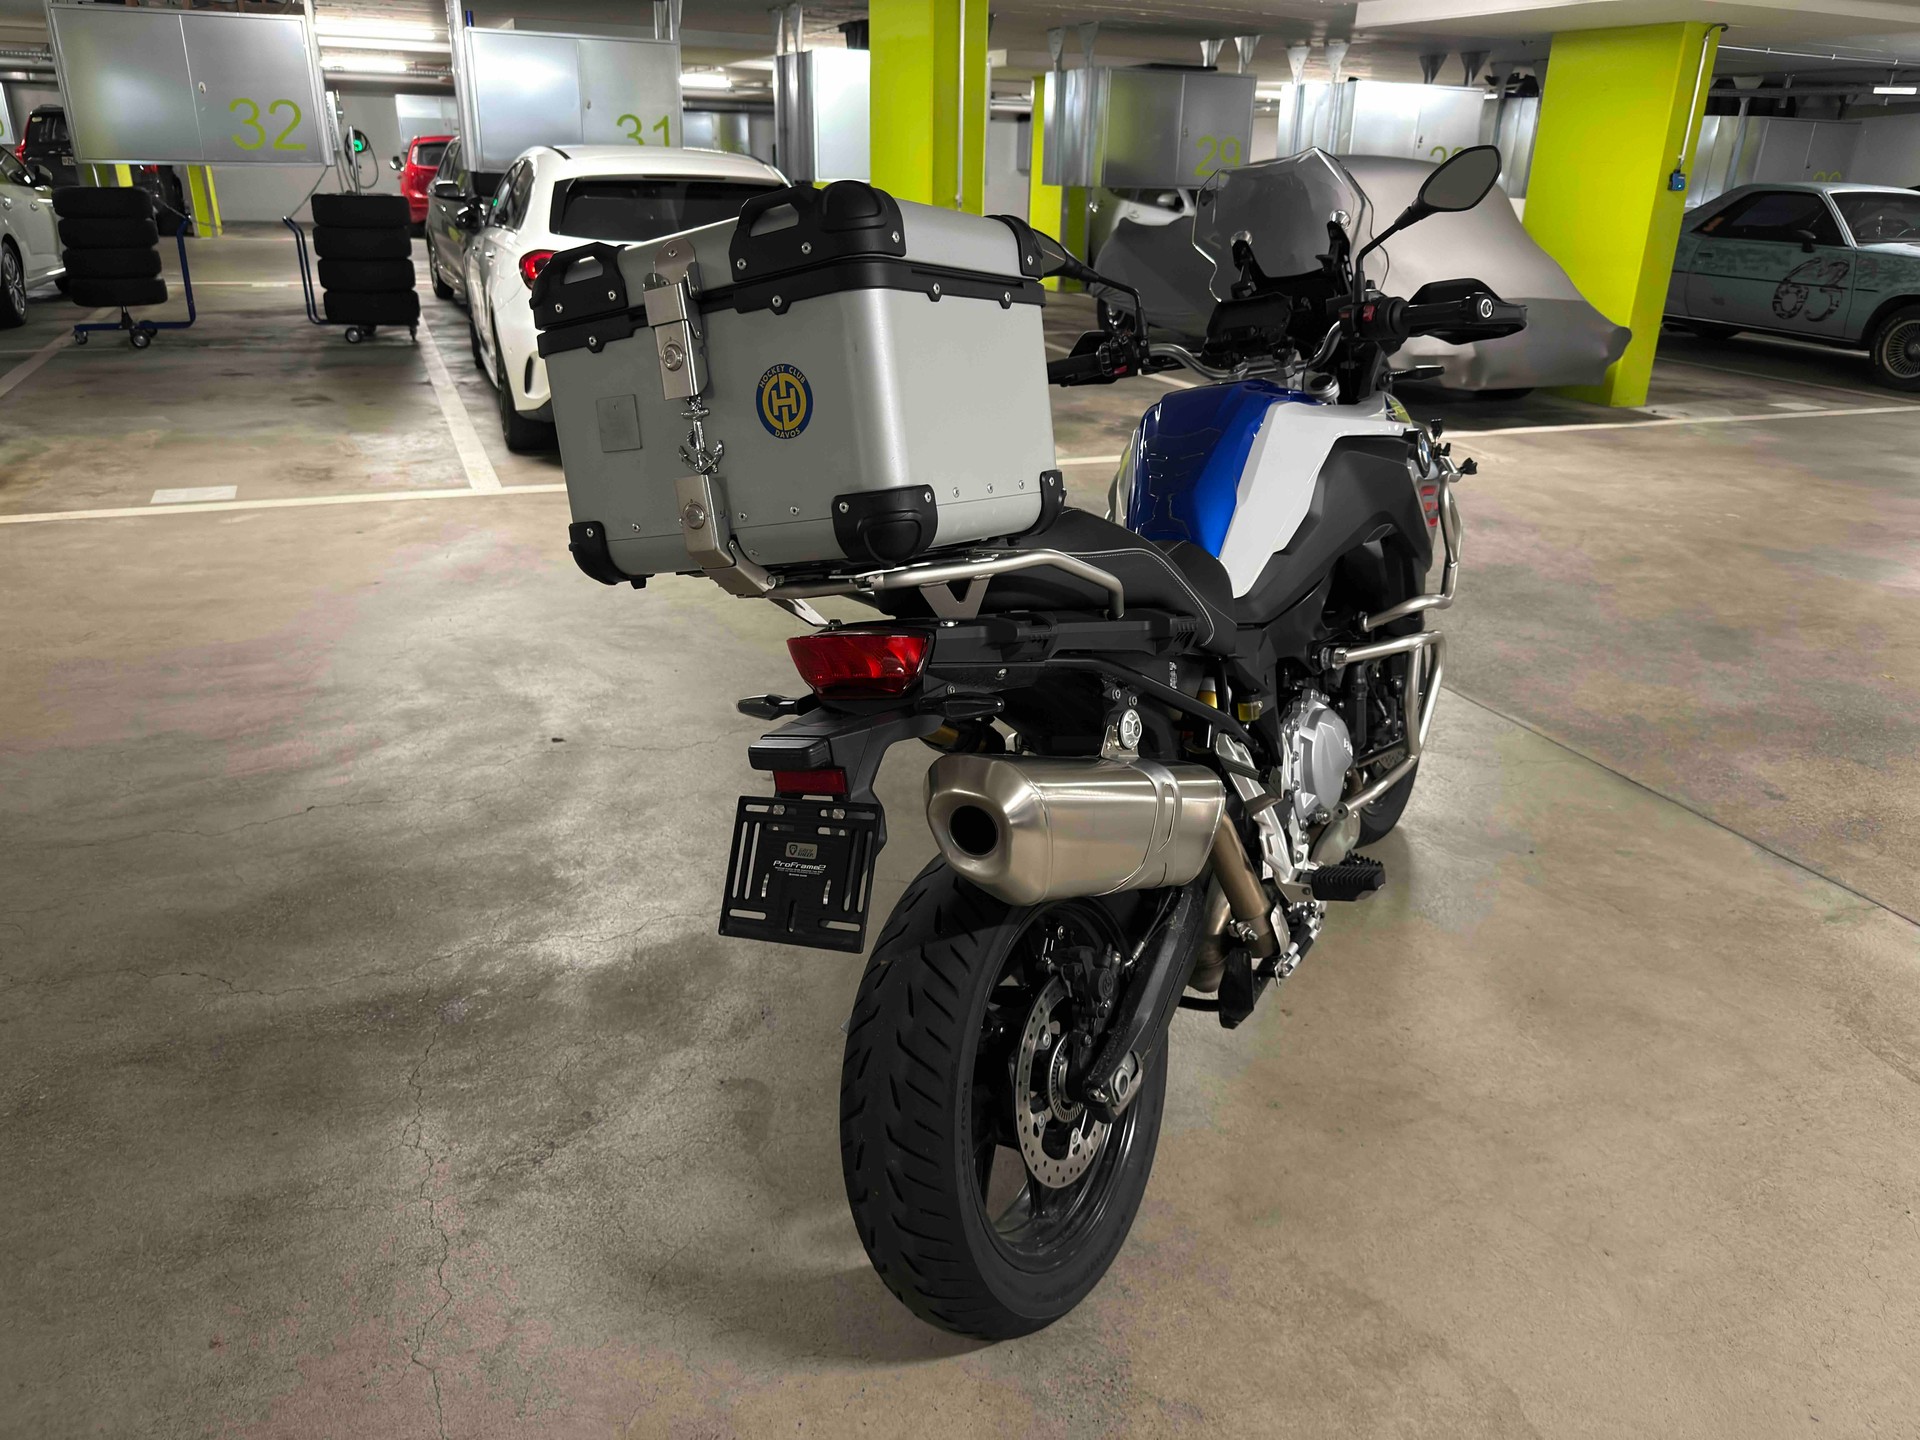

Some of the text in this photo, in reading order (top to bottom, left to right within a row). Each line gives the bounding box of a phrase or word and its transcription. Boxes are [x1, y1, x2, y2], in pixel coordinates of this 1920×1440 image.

[229, 98, 307, 151] 32
[1194, 135, 1240, 176] 29
[759, 365, 806, 388] HOCKEY CLUB
[774, 427, 801, 439] DAVOS
